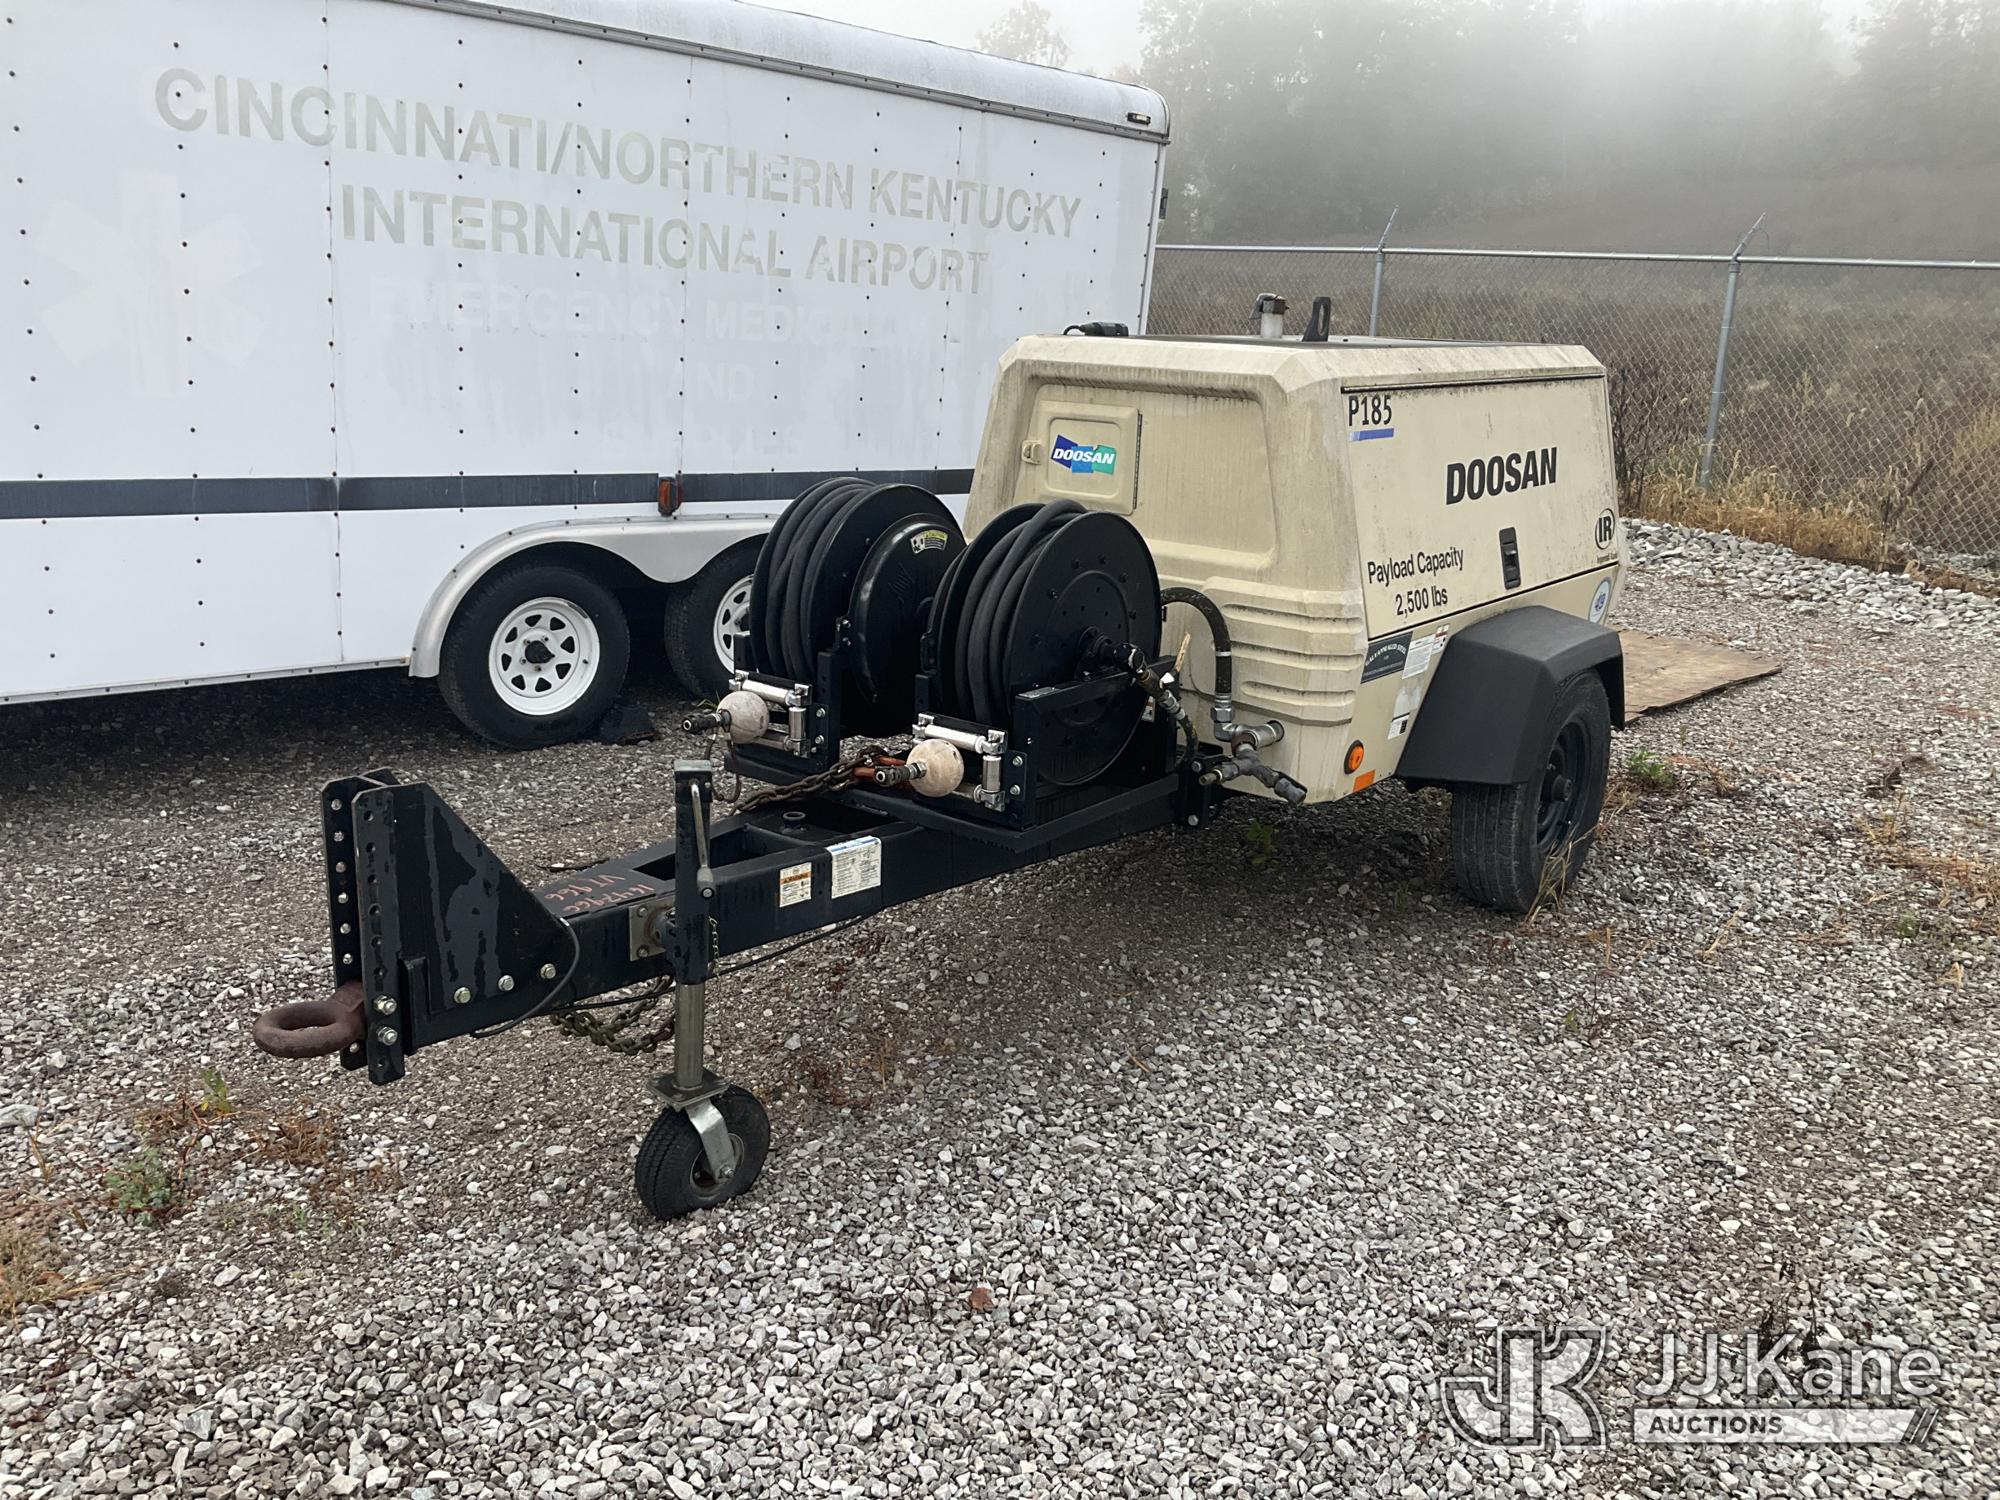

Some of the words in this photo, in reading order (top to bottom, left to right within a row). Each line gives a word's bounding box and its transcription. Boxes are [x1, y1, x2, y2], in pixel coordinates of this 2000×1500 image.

[155, 68, 853, 209] CINCINNATI/NORTHERN
[869, 167, 1081, 238] KENTUCKY
[342, 184, 791, 279] INTERNATIONAL
[805, 235, 989, 295] AIRPORT
[1348, 395, 1393, 426] P185
[1053, 448, 1116, 465] DOOSAN
[1446, 447, 1557, 505] DOOSAN
[1598, 516, 1612, 543] IR
[1368, 552, 1415, 588] Payload
[1417, 546, 1464, 578] Capacity
[1395, 592, 1430, 620] 2,500
[1431, 586, 1448, 609] lbs
